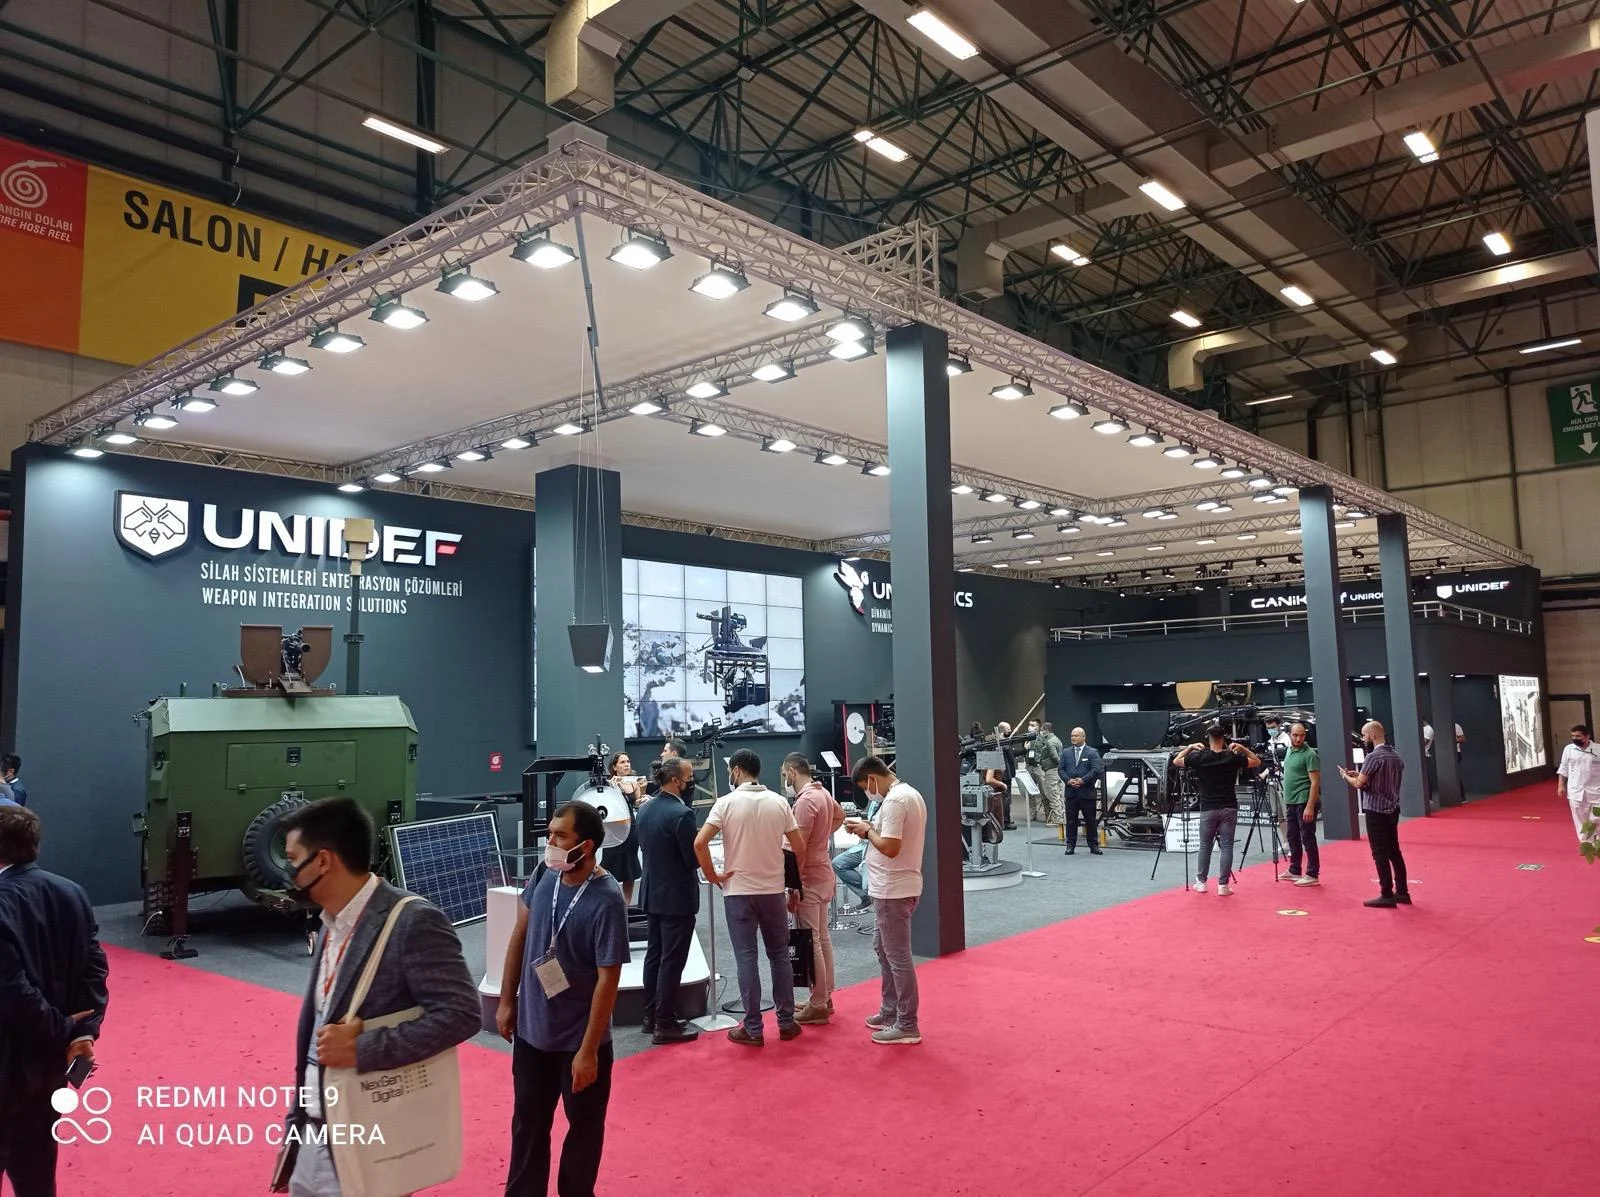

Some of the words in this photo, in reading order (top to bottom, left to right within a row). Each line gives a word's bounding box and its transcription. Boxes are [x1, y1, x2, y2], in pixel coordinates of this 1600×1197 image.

[0, 203, 32, 220] ANGIN
[19, 221, 47, 235] HOSE
[48, 229, 72, 242] REEL
[124, 189, 261, 262] SALON
[273, 236, 289, 272] /
[203, 503, 463, 566] UNIDEF
[200, 560, 239, 581] SİLAH
[244, 564, 316, 587] SİSTEMLERİ
[322, 572, 400, 592] ENTERASYON
[404, 577, 463, 597] ÇÖZÜMLERİ
[1455, 581, 1510, 593] UNIDEF
[872, 582, 892, 600] UN
[1349, 592, 1384, 601] UNIRO
[202, 588, 257, 607] WEAPON
[262, 591, 341, 612] INTEGRATION
[346, 596, 407, 614] SLUTIONS
[361, 1074, 402, 1092] NexGen
[371, 1084, 404, 1103] Digital
